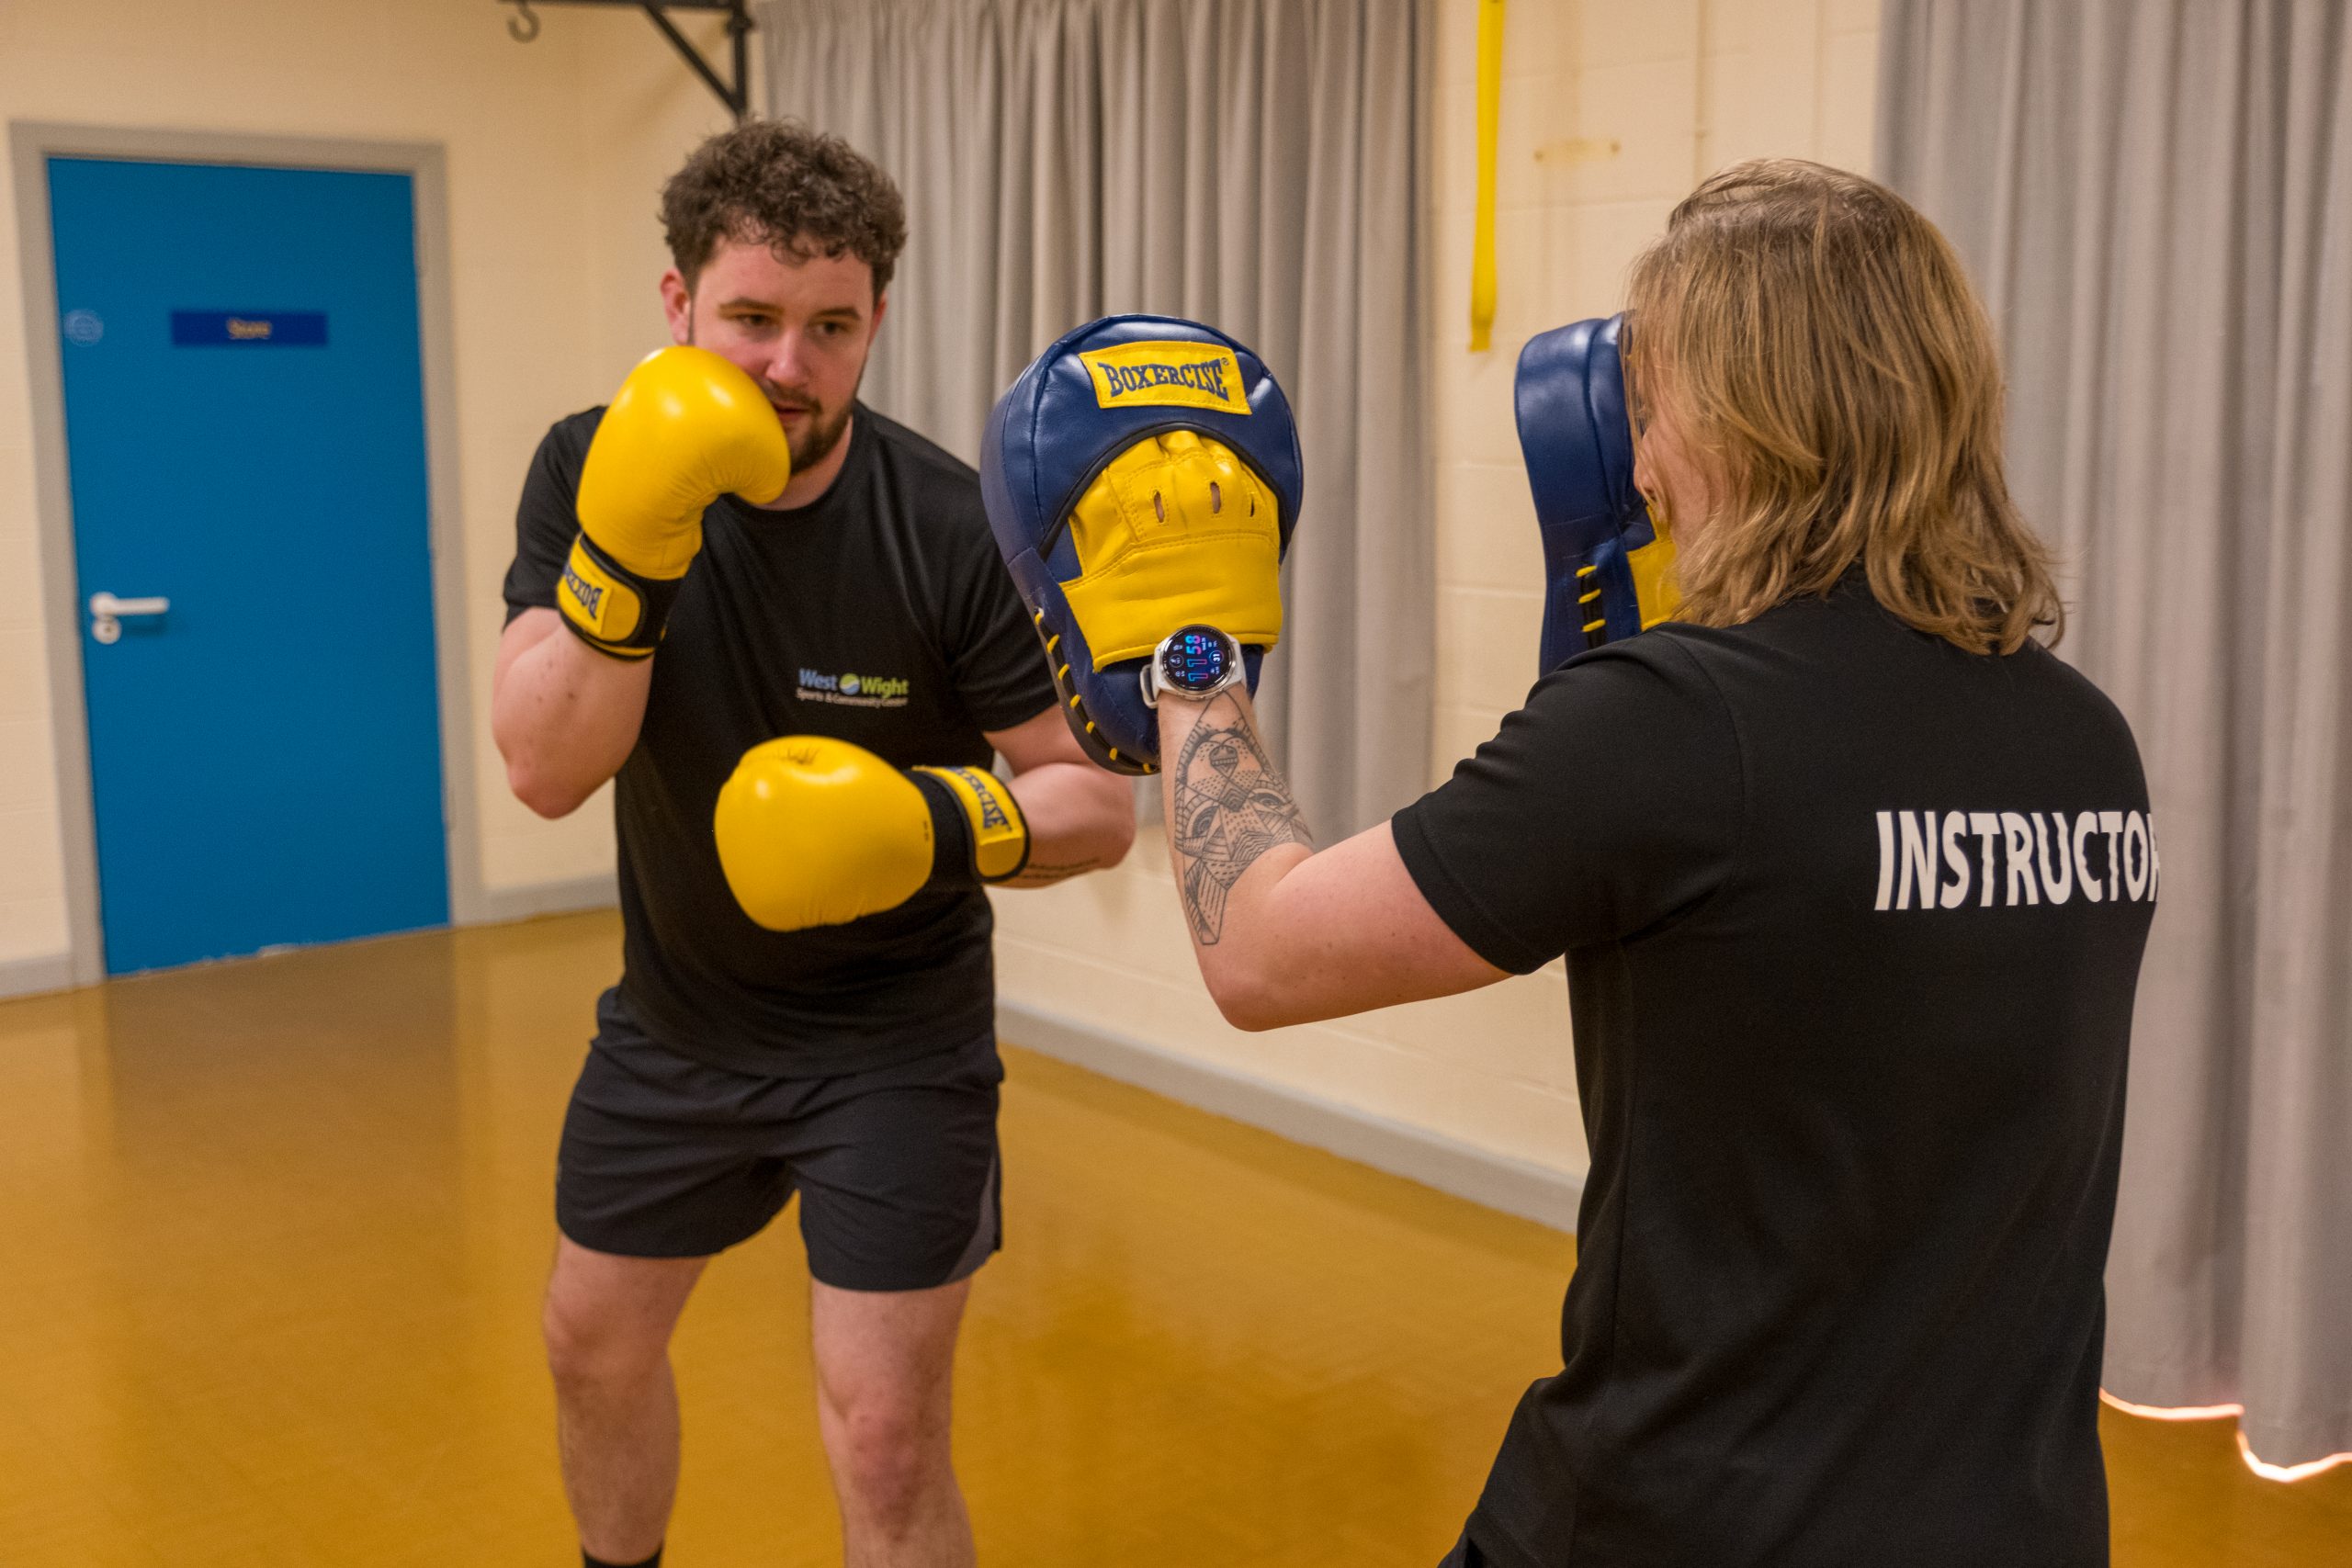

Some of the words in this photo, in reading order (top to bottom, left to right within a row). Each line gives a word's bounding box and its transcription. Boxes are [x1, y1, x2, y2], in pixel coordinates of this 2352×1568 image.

[1097, 358, 1229, 401] BOXERCISE
[799, 668, 838, 691] West
[861, 676, 910, 699] Wight
